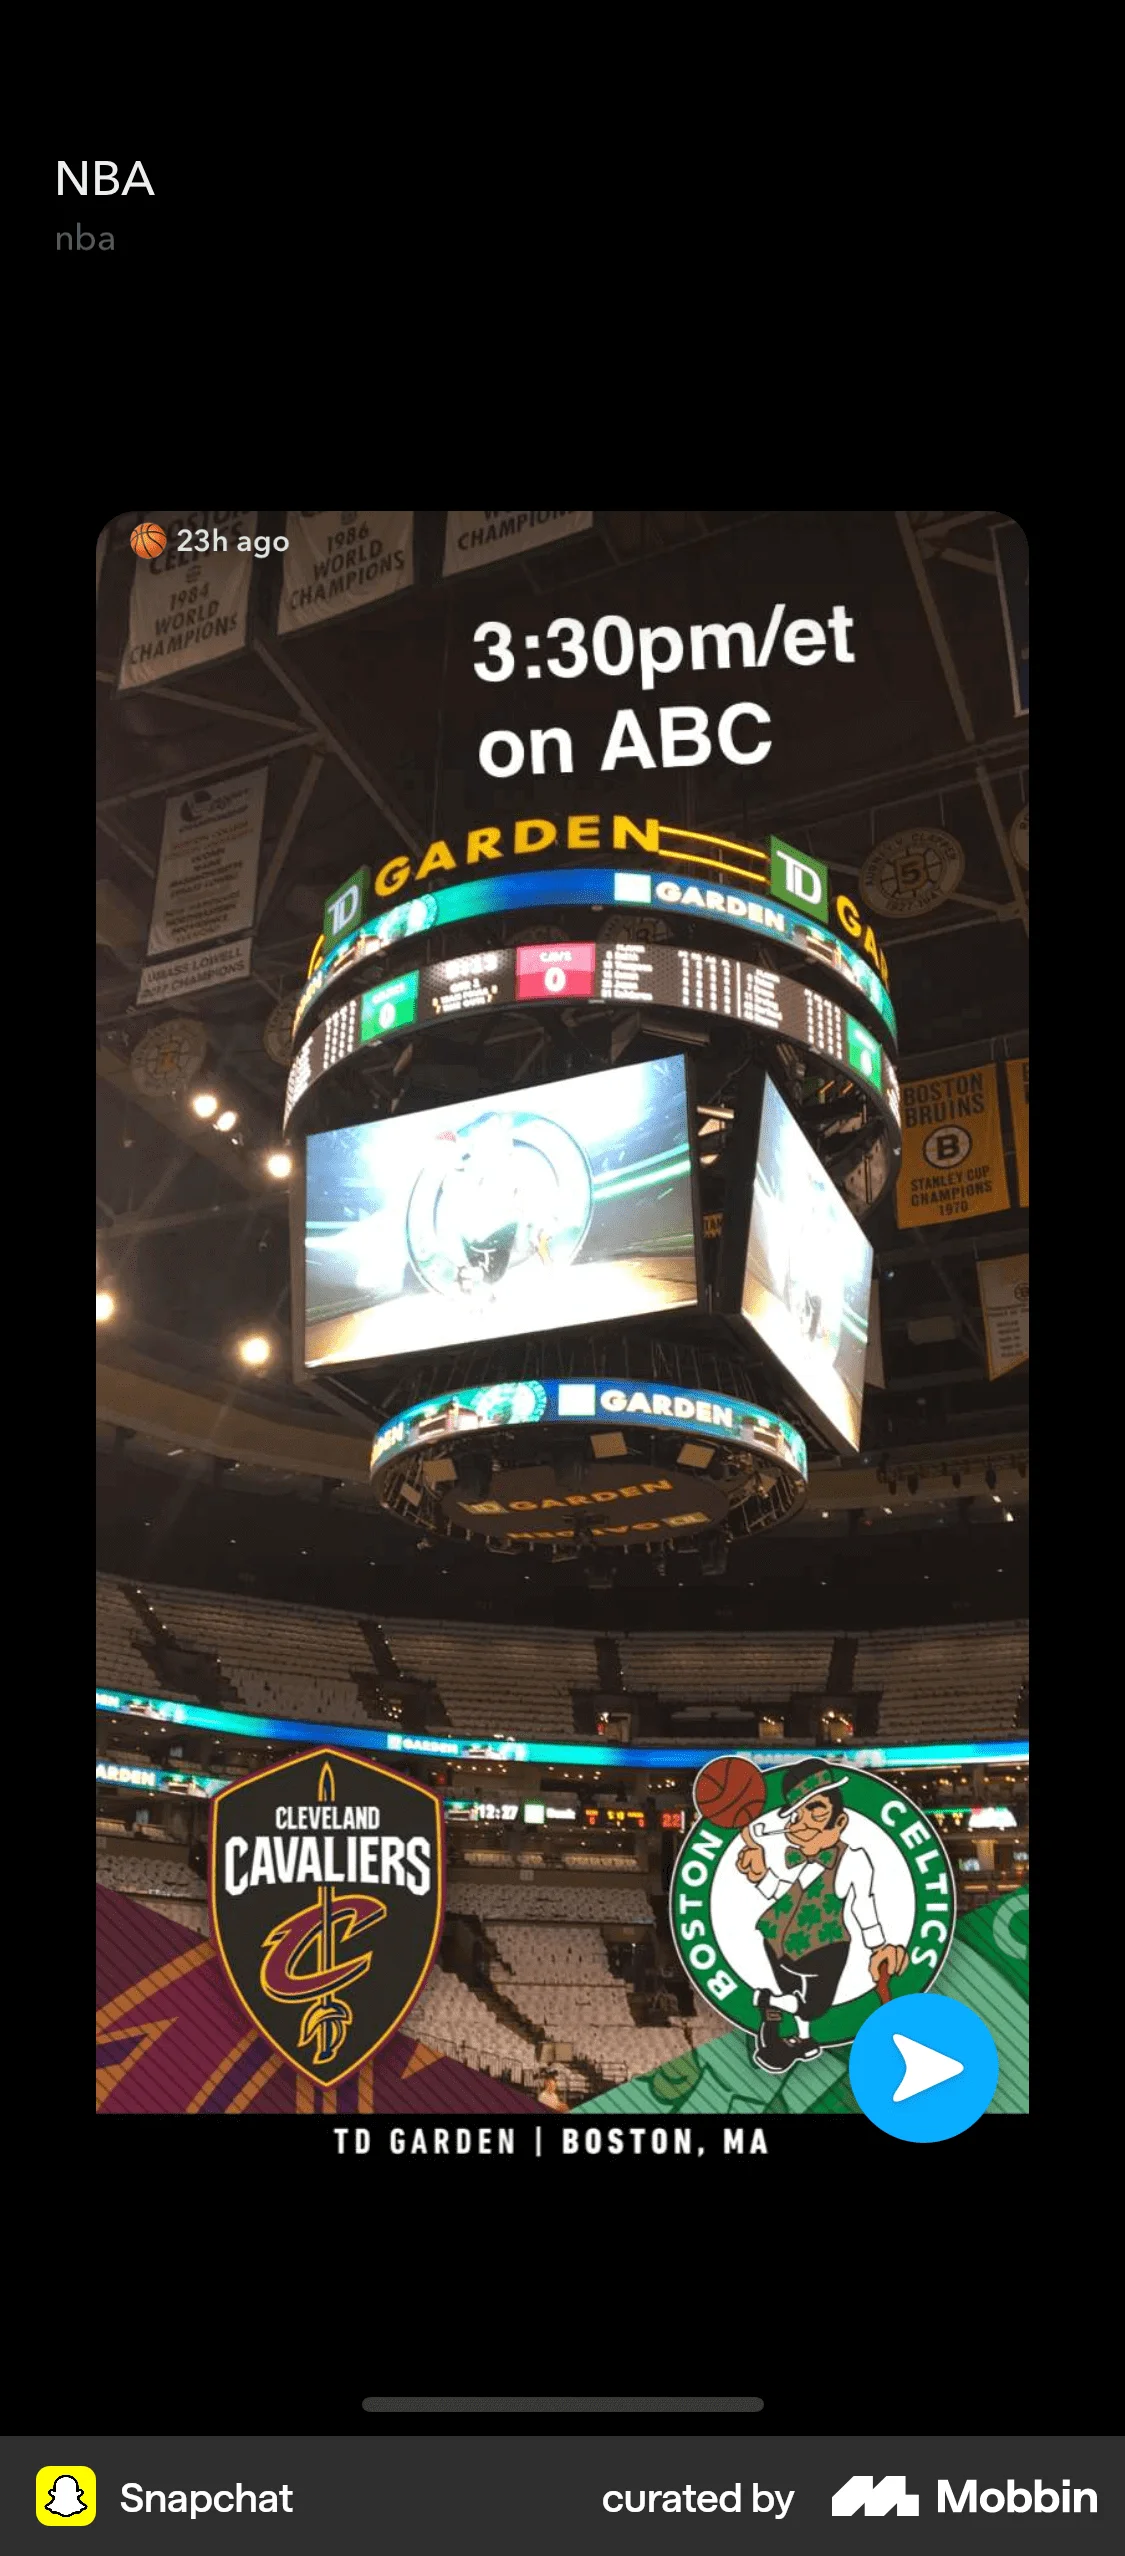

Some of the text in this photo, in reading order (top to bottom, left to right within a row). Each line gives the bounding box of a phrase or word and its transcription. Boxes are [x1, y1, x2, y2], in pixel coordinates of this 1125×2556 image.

[327, 520, 370, 554] 1986
[313, 539, 383, 580] WORLD
[170, 581, 210, 612] 1984
[290, 549, 405, 611] CHAMPIONS
[155, 600, 220, 636] WORLD
[130, 613, 239, 665] CHAMPIONS
[374, 815, 660, 898] GARDEN
[899, 857, 922, 887] 5
[775, 850, 822, 905] TD
[327, 884, 360, 937] TD
[655, 881, 785, 932] GARDEN
[172, 959, 245, 989] CHAMPIONS
[544, 967, 567, 993] 0
[379, 1002, 396, 1029] 0
[904, 1072, 983, 1105] BOSTON
[904, 1094, 985, 1129] BRUINS
[936, 1134, 960, 1160] B
[911, 1165, 990, 1192] STANLEY CUP
[911, 1180, 992, 1206] CHAMPIONS
[939, 1201, 969, 1216] 1970
[600, 1389, 733, 1429] GARDEN
[508, 1479, 673, 1511] GARDEN
